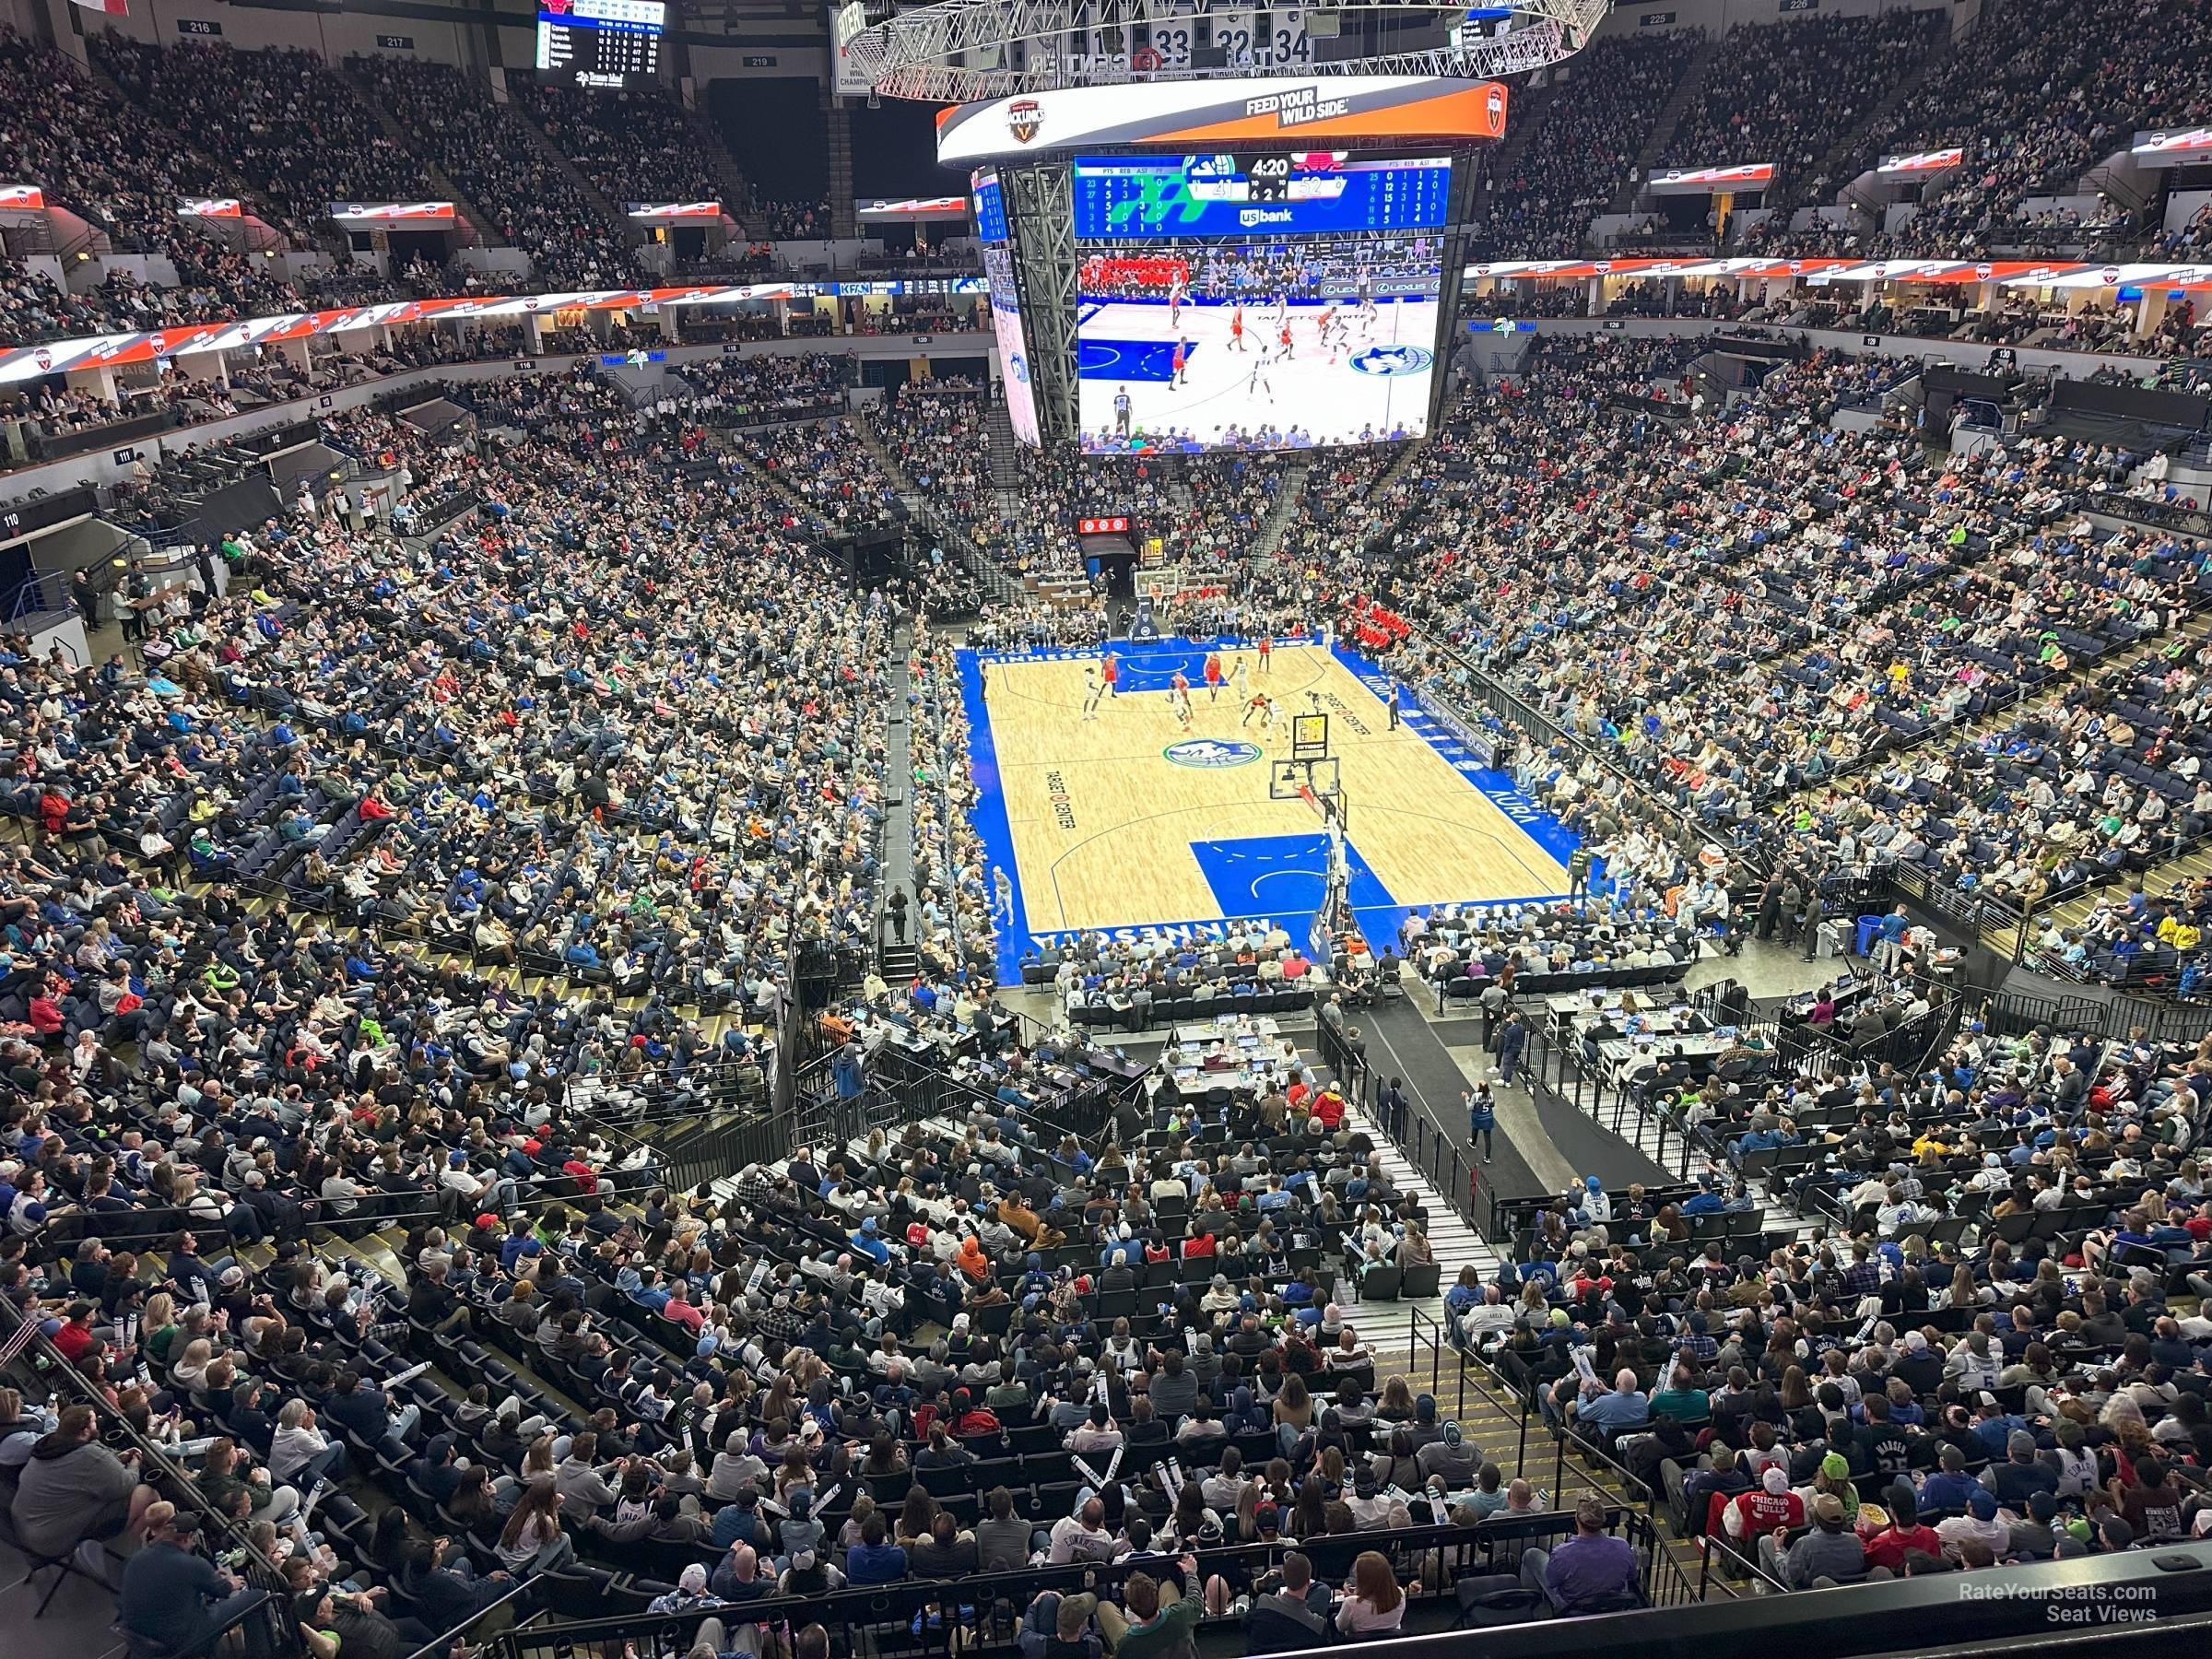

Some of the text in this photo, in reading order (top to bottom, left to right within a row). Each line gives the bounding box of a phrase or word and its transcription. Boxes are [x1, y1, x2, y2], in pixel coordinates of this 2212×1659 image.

[191, 22, 210, 32] 216
[388, 38, 403, 46] 217
[1276, 29, 1309, 63] 34
[752, 58, 767, 66] 219
[1246, 88, 1314, 116] FEED YOUR
[1282, 105, 1316, 125] WILD
[1251, 159, 1288, 176] 4:20
[1212, 179, 1233, 198] 41
[1300, 176, 1322, 195] 52
[1402, 182, 1407, 191] 2
[1417, 182, 1422, 190] 2
[1251, 188, 1285, 201] 6 2 4
[1384, 194, 1393, 203] 15
[1384, 205, 1390, 213] 8
[1416, 204, 1420, 212] 3
[1430, 203, 1436, 211] 0
[1106, 213, 1112, 221] 3
[1383, 216, 1389, 224] 5
[1106, 224, 1112, 232] 4
[1123, 224, 1128, 232] 3
[1157, 223, 1162, 231] 0
[841, 283, 870, 294] KFAN
[2000, 349, 2010, 359] 130
[271, 434, 281, 444] 112
[119, 451, 131, 463] 111
[4, 513, 18, 527] 110
[1423, 700, 1440, 716] LEXUS
[1343, 715, 1371, 735] CENTER
[1447, 720, 1465, 737] LEXUS
[1473, 741, 1492, 760] LEXUS
[1046, 771, 1077, 830] TARGET CENTER
[1482, 1104, 1489, 1113] 5
[1596, 1204, 1603, 1215] 5
[1983, 1376, 1994, 1388] 5
[1875, 1440, 1908, 1456] MADSEN
[2081, 1478, 2092, 1491] 5
[1751, 1495, 1789, 1506] CHICAGO
[1757, 1504, 1785, 1513] BULLS
